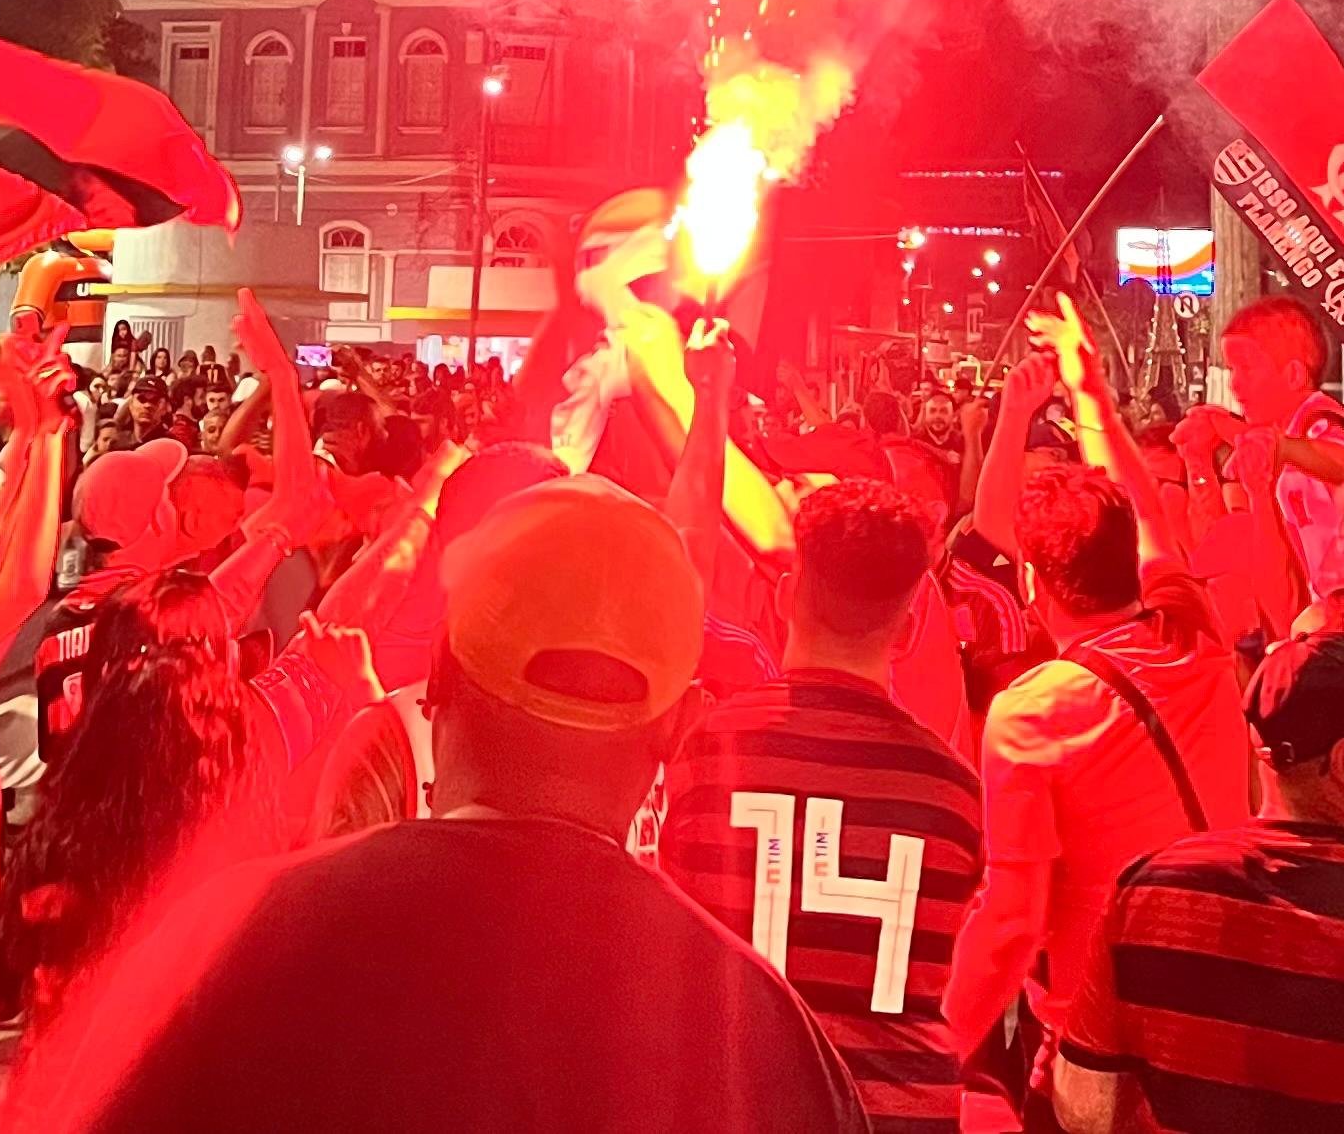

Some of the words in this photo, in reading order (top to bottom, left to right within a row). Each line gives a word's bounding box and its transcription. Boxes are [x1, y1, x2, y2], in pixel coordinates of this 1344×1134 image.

[1236, 191, 1324, 288] FLAMENGO
[1252, 170, 1298, 218] ISSO
[1291, 214, 1336, 263] AQUI
[730, 792, 925, 1013] 14
